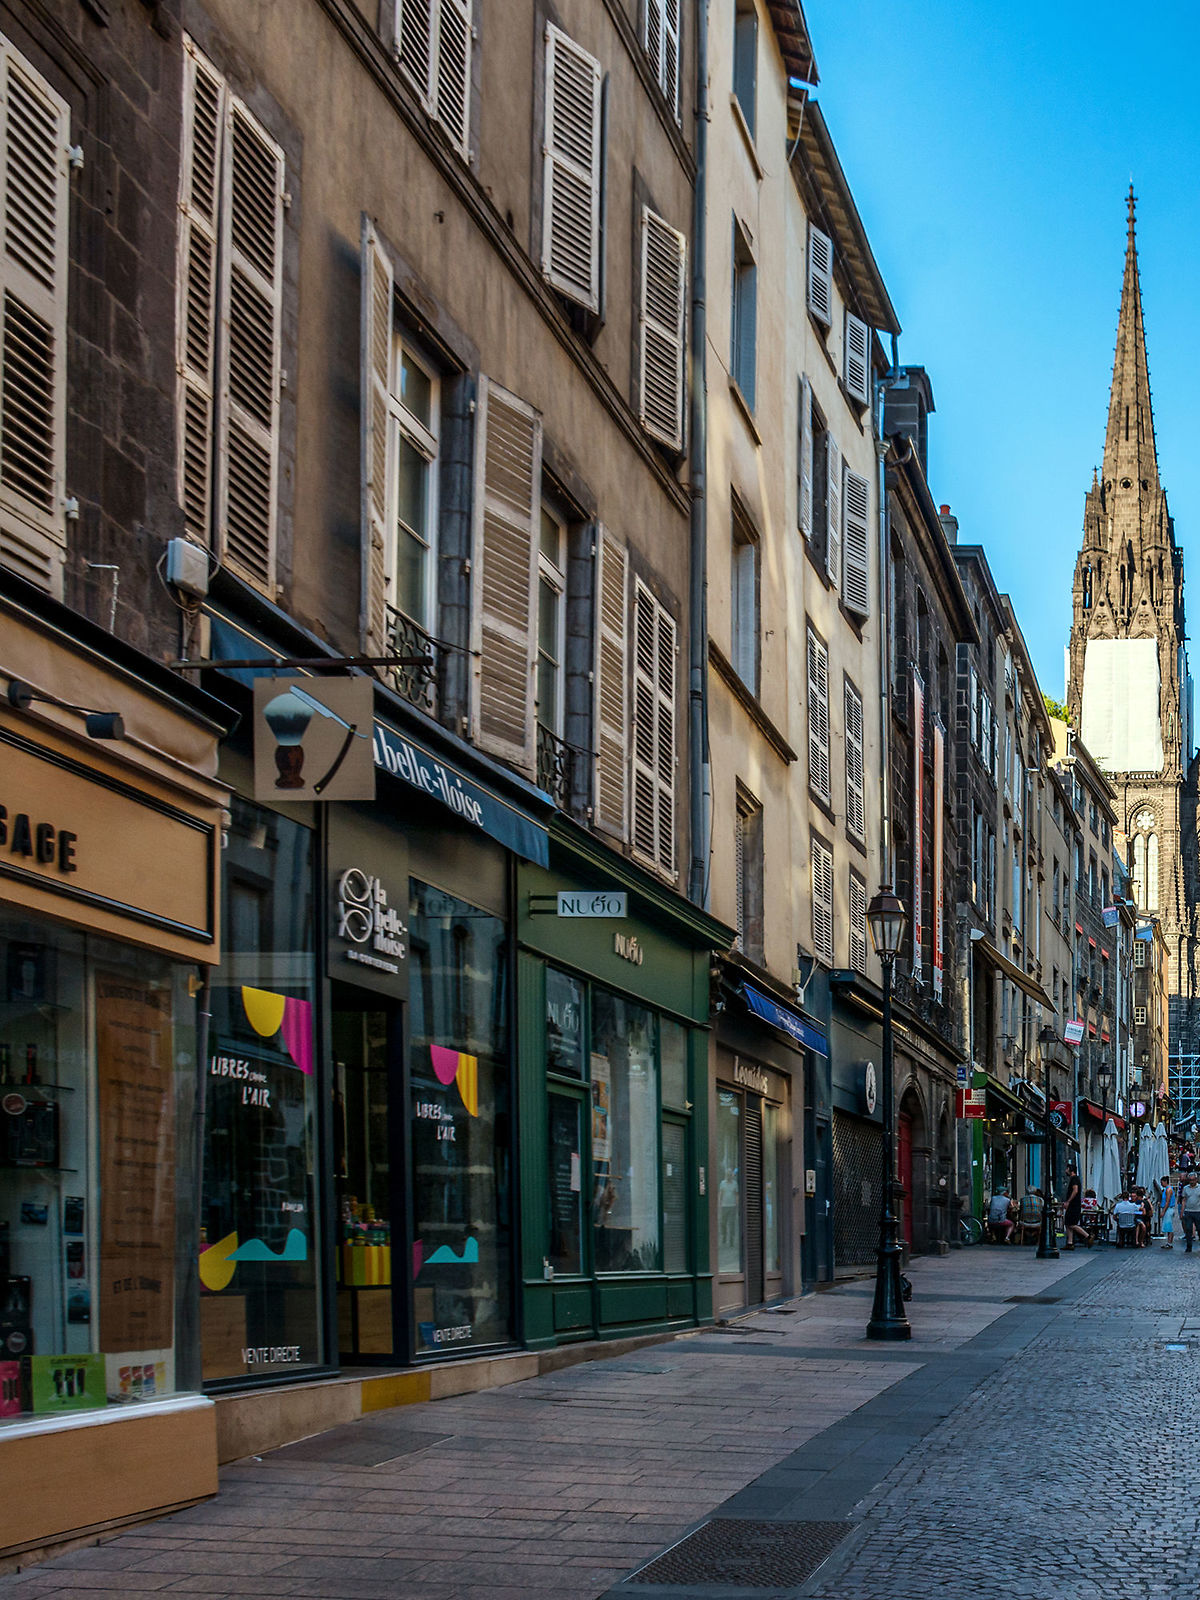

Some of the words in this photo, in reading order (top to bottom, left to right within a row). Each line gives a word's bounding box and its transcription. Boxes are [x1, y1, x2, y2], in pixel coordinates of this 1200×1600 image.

[211, 1055, 250, 1079] LIBRES
[242, 1086, 271, 1109] L'AIR
[416, 1101, 442, 1120] LIBRES
[241, 1347, 269, 1364] VENTE
[270, 1346, 301, 1363] DIRECTE
